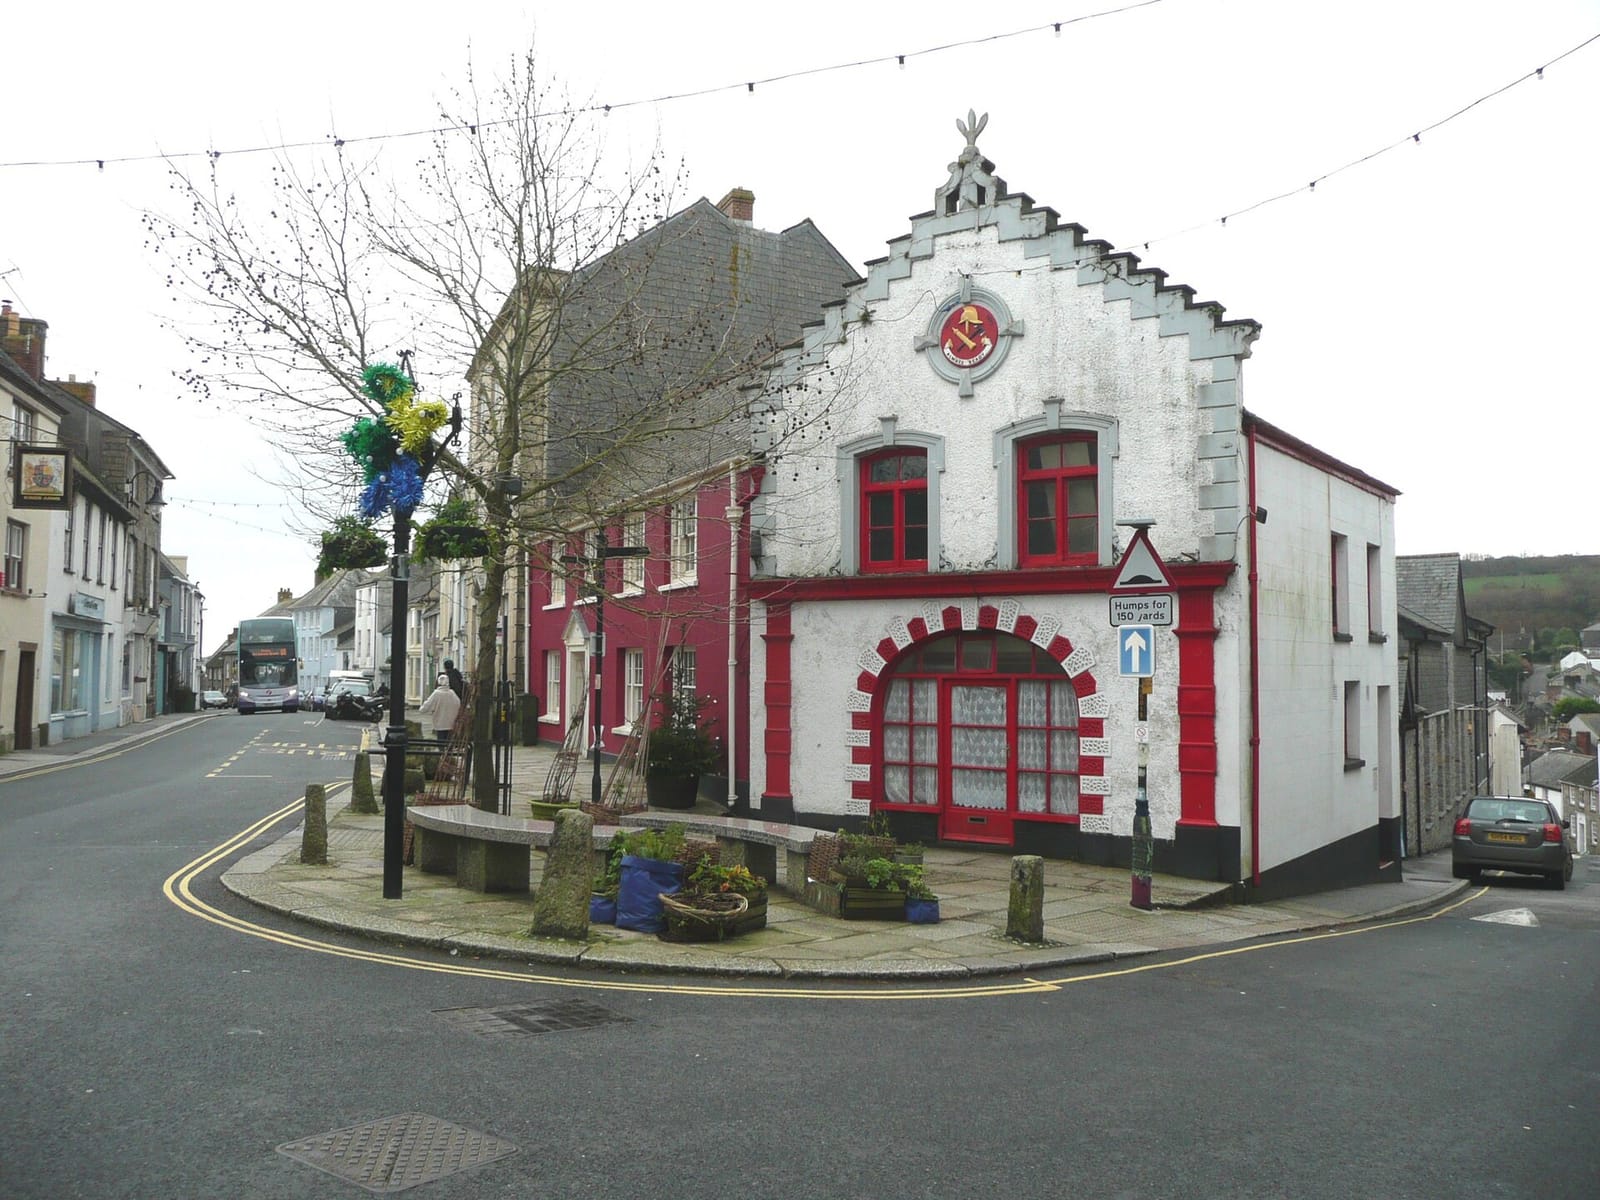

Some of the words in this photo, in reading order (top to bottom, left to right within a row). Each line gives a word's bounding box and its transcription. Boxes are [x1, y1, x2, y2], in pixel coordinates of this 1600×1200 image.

[1114, 601, 1149, 611] Humps
[1152, 600, 1167, 609] for
[1117, 612, 1134, 621] 150
